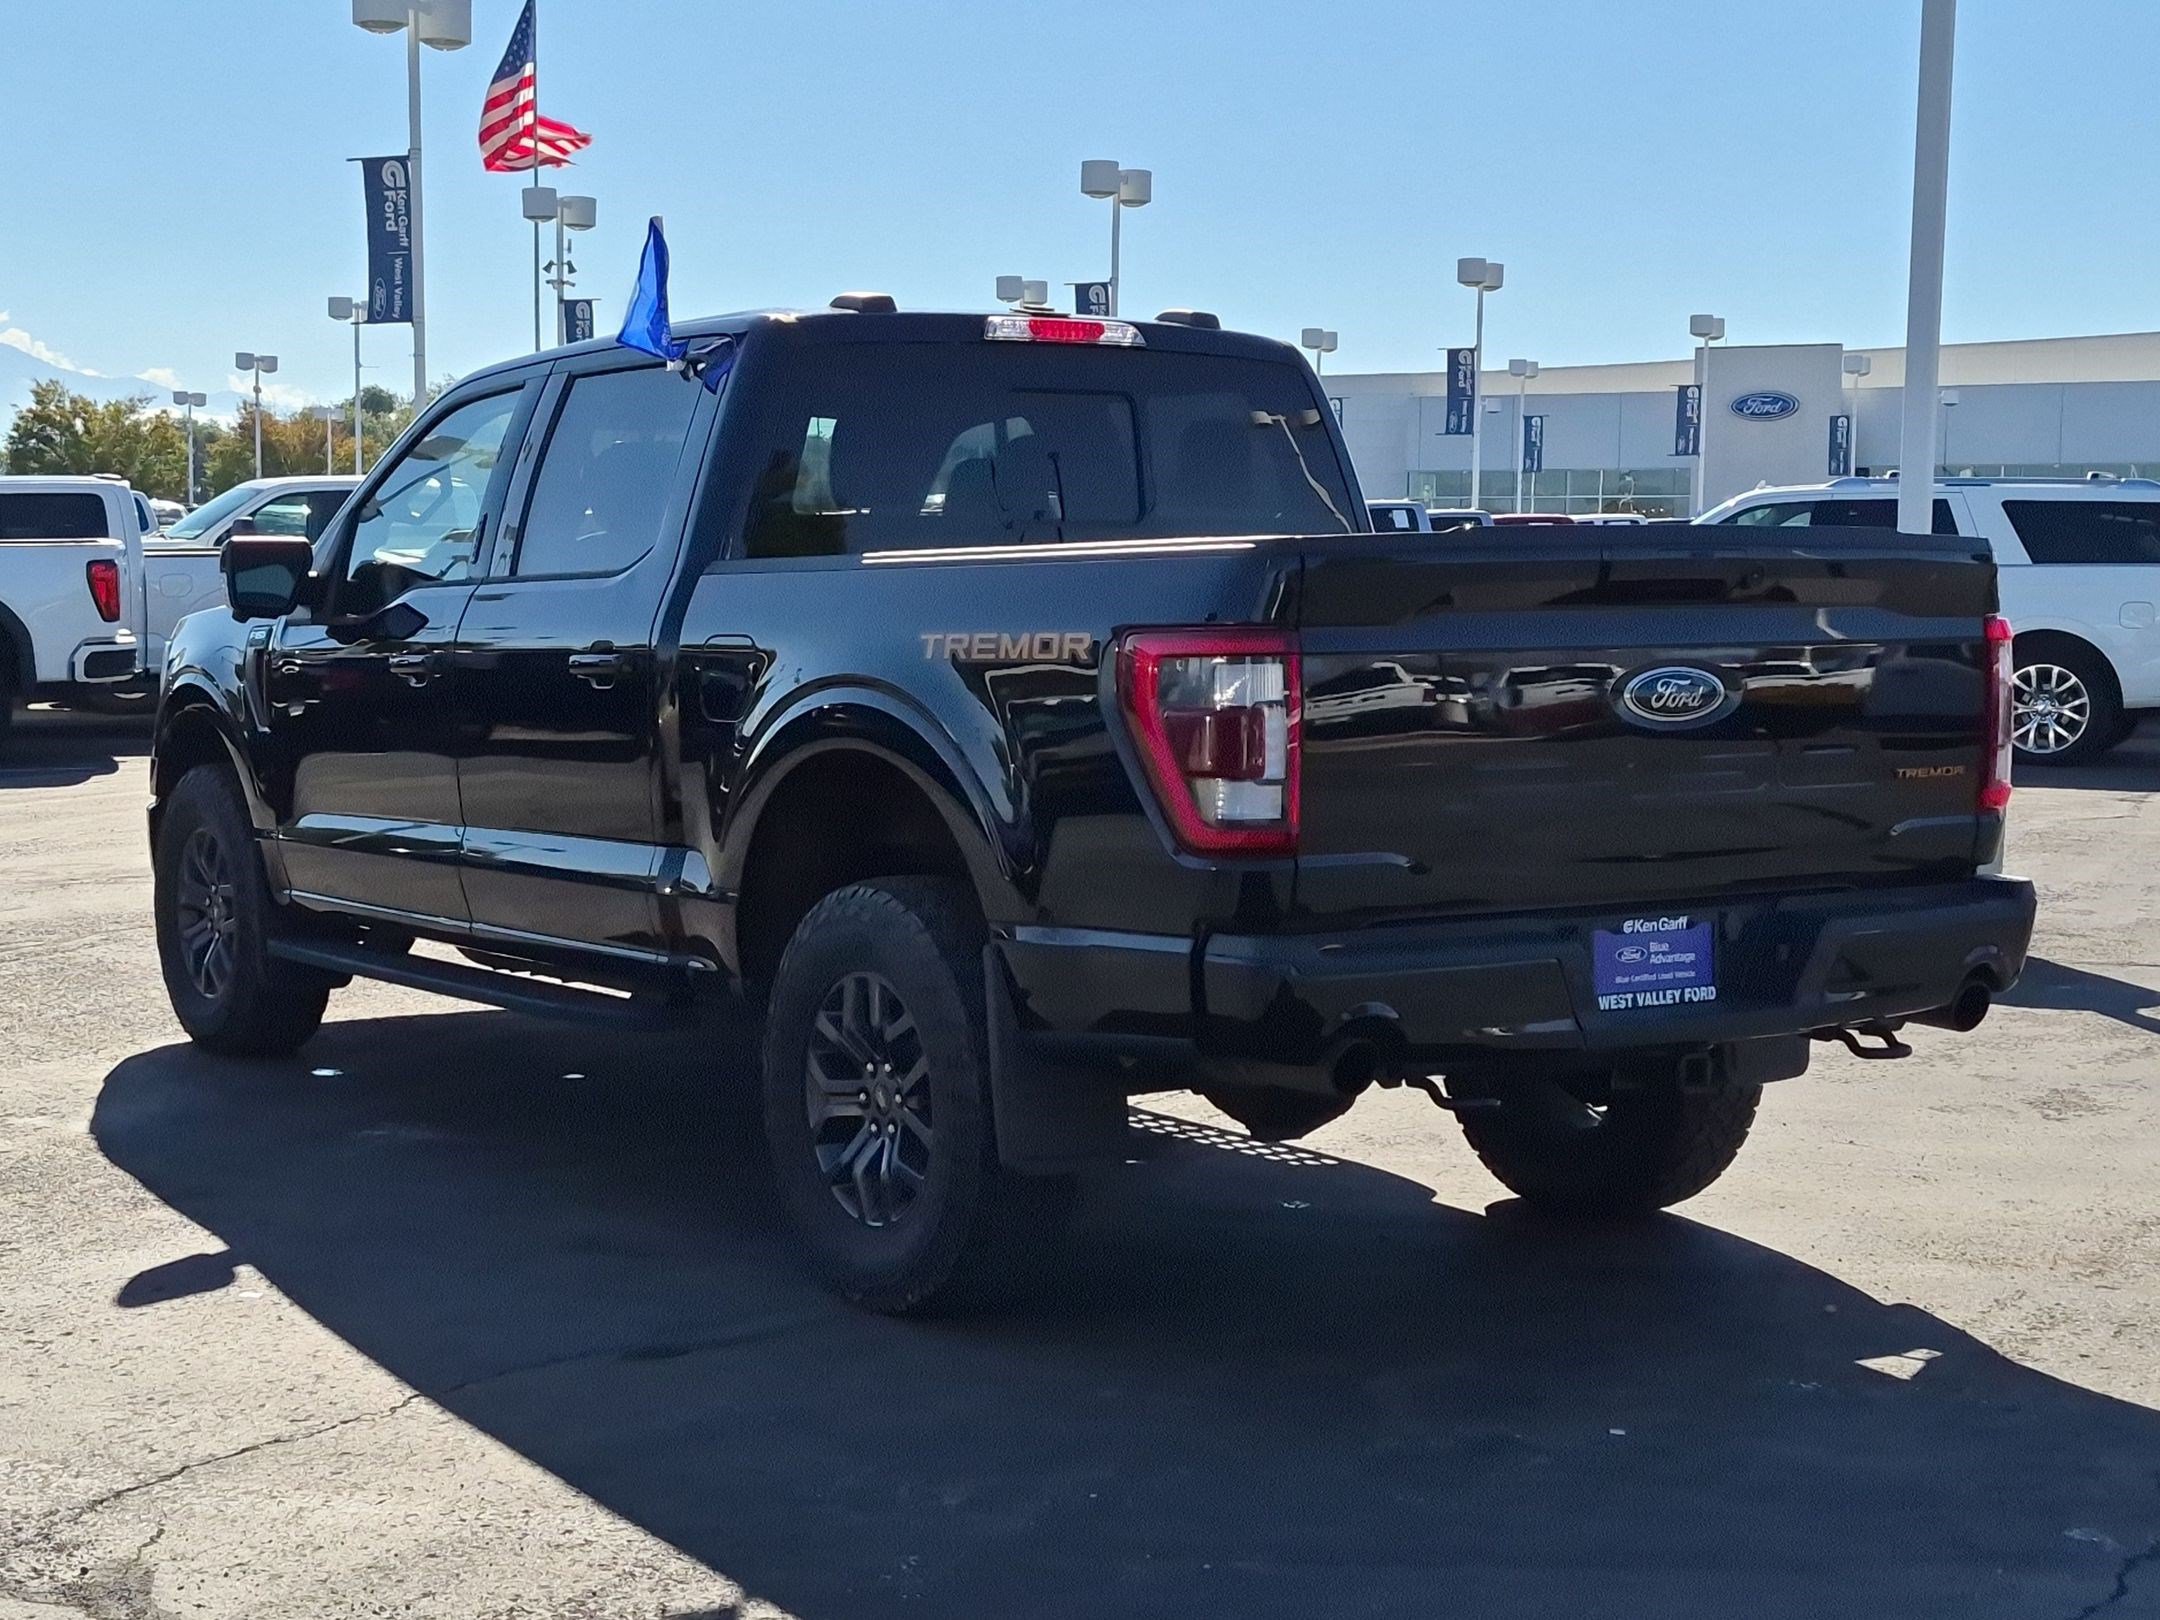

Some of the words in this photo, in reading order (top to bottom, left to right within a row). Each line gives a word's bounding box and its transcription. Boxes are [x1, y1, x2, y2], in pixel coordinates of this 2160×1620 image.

[384, 190, 398, 231] Ford
[397, 190, 407, 214] Ken
[398, 216, 409, 247] Garff
[394, 257, 403, 285] West
[392, 287, 403, 319] Valley
[1743, 397, 1783, 414] Ford
[921, 632, 1091, 660] TREMOR
[1651, 678, 1704, 709] Ford
[1896, 765, 1967, 778] TREMOR
[1634, 919, 1657, 933] Ken
[1659, 916, 1688, 931] Garff
[1649, 952, 1696, 964] Advantage
[1598, 993, 1633, 1010] WEST
[1636, 989, 1682, 1007] VALLEY
[1683, 986, 1717, 1002] FORD
